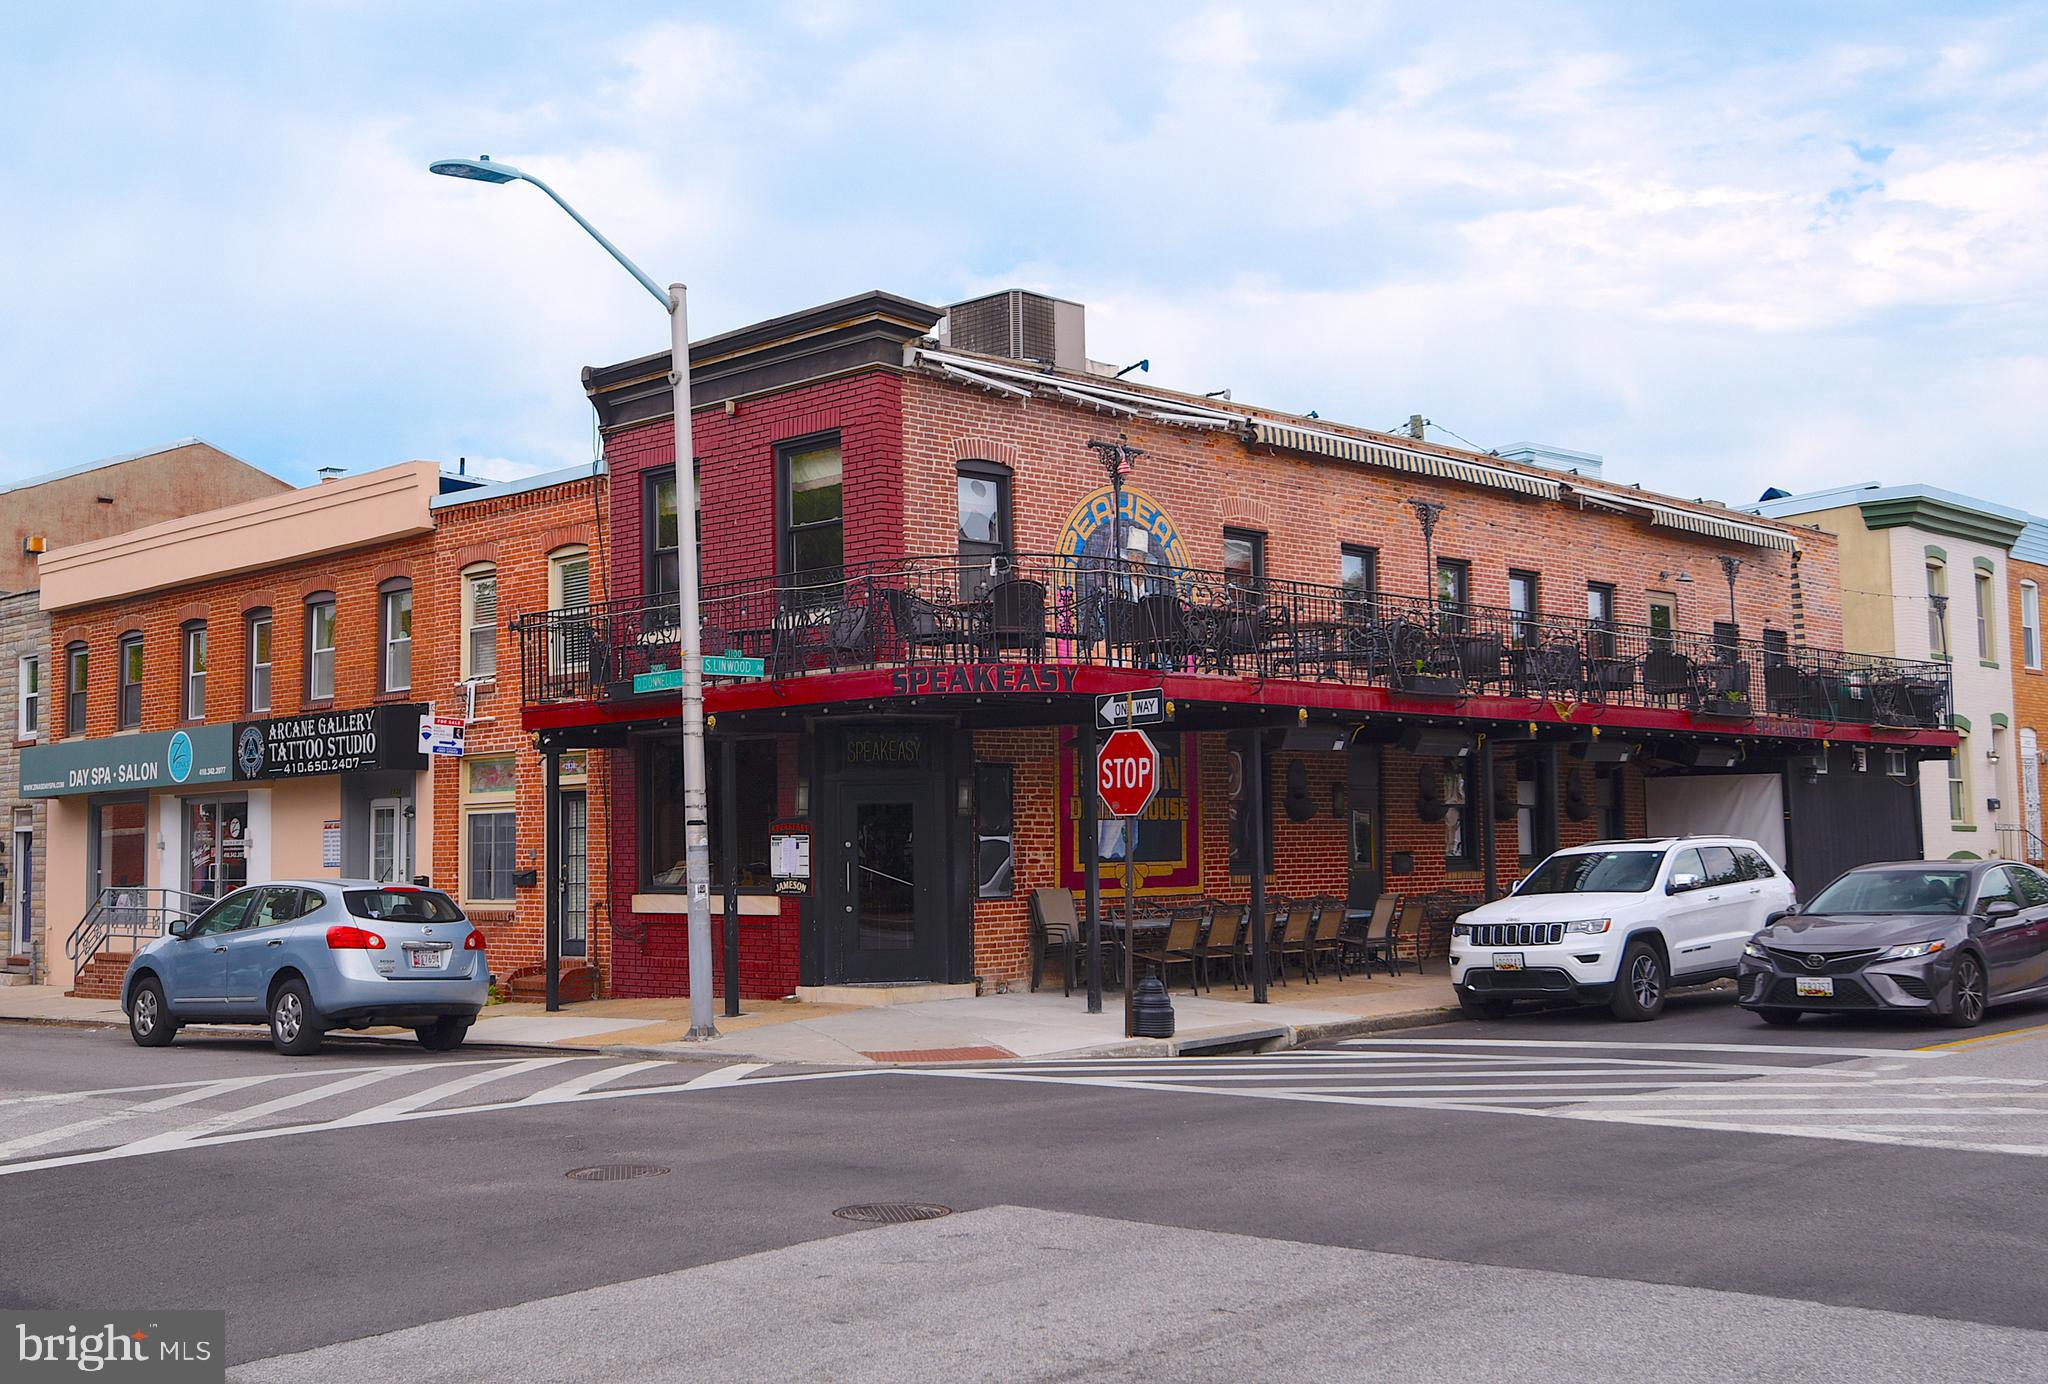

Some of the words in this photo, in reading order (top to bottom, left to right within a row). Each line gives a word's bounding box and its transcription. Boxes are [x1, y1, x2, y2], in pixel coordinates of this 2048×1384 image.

[893, 665, 1079, 695] SPEAKEASY
[1115, 703, 1132, 717] ON
[1136, 700, 1155, 714] WAY
[268, 719, 316, 741] ARCANE
[318, 709, 376, 735] GALLERY
[268, 738, 324, 762] TATTOO
[327, 732, 376, 757] STUDIO
[847, 740, 920, 762] SPEAKEASY
[69, 768, 89, 787] DAY
[92, 766, 111, 785] SPA
[118, 762, 158, 784] SALON
[284, 757, 360, 774] 410.650.2407
[1102, 757, 1151, 789] STOP
[775, 880, 807, 893] JAMESON
